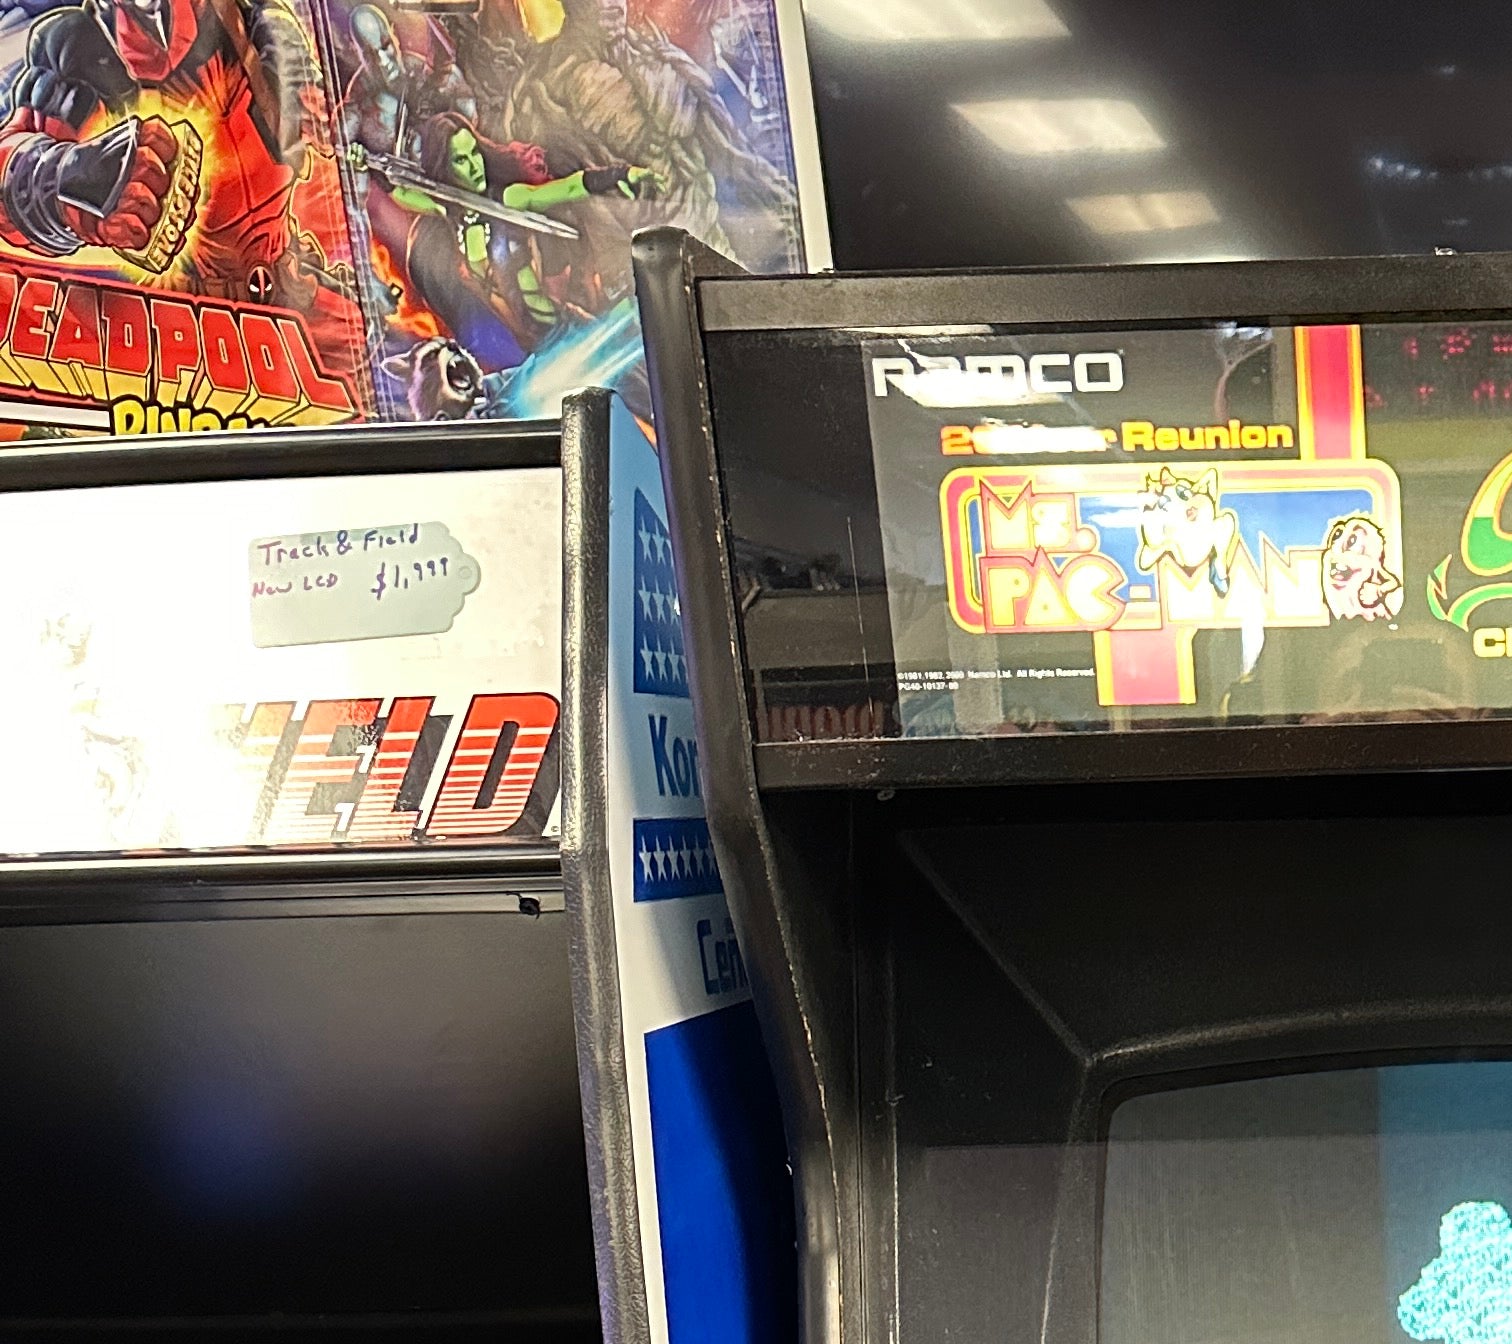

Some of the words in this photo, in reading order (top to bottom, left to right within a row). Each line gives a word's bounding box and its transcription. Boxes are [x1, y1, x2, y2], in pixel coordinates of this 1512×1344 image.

[1121, 419, 1294, 452] Reunion
[257, 536, 330, 565] Track
[337, 529, 352, 555] &
[363, 522, 418, 551] Field
[979, 479, 1097, 553] MS.
[304, 573, 338, 591] LCD
[370, 557, 448, 600] $1,999
[979, 531, 1331, 634] PAC-MAN
[212, 692, 561, 840] IELD
